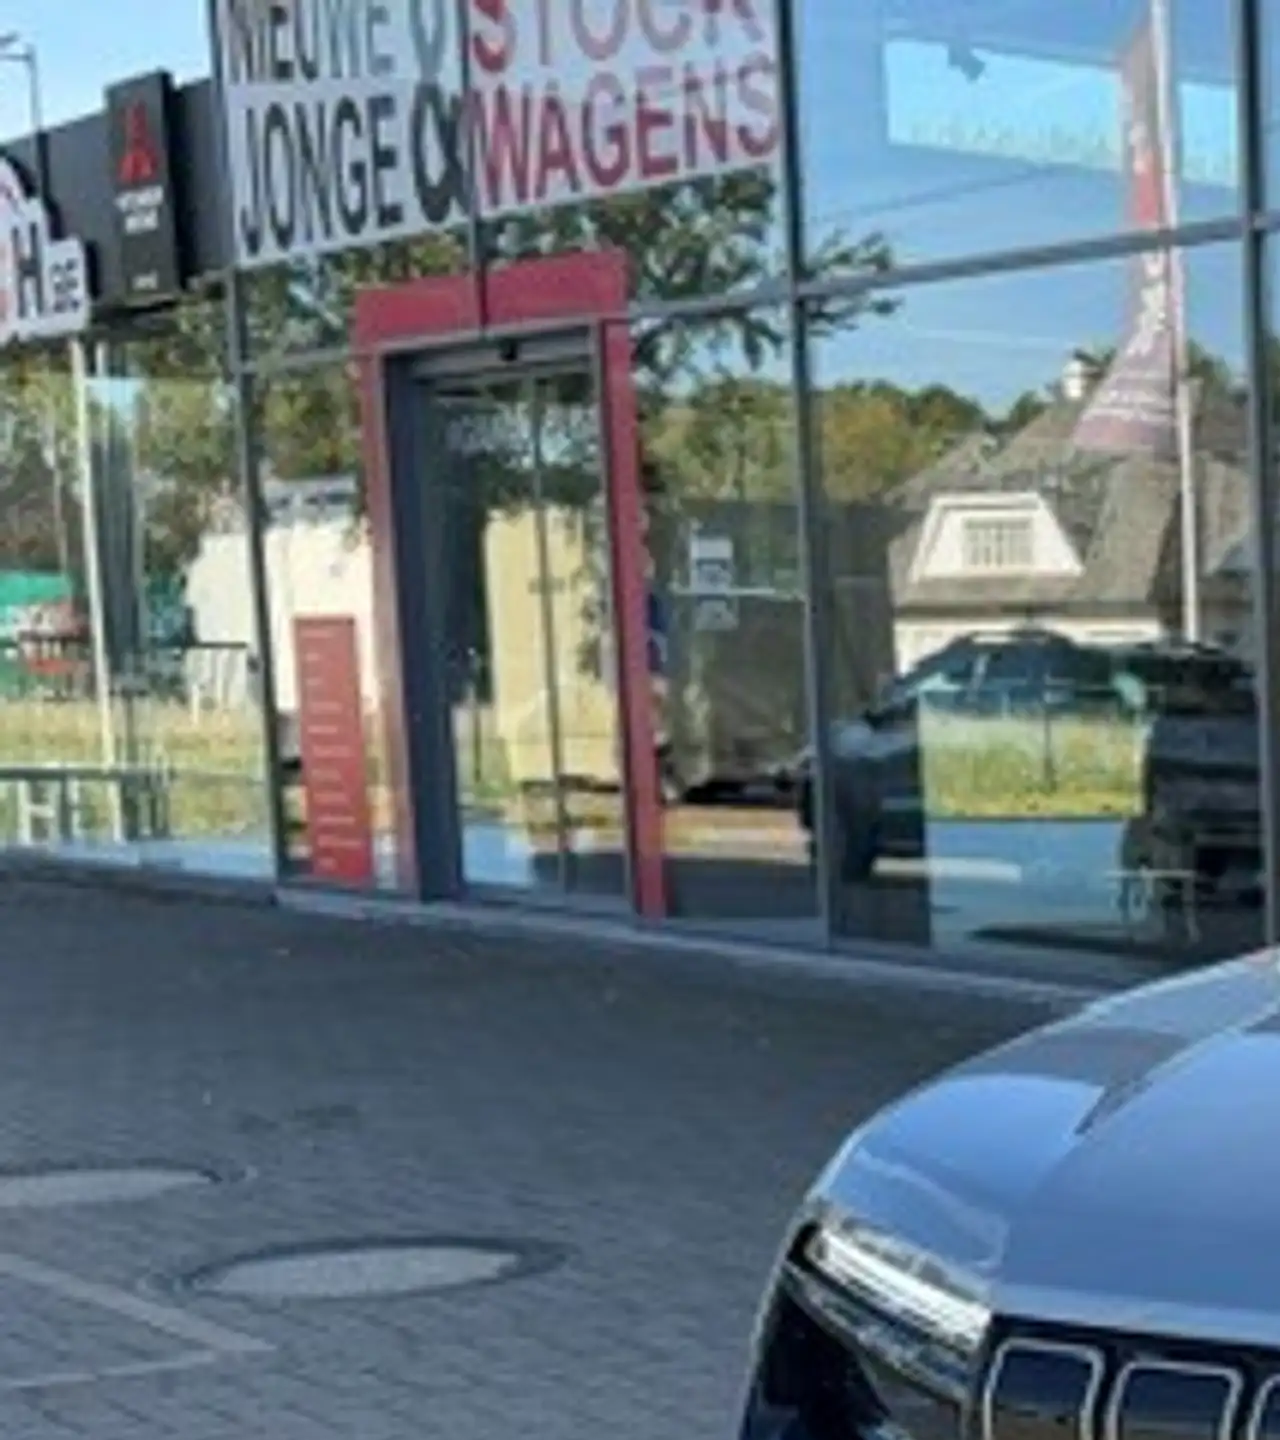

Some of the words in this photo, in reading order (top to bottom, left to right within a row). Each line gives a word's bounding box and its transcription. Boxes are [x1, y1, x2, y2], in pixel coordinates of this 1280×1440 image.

[227, 0, 395, 84] NIEUWE
[239, 95, 404, 257] JONGE
[462, 52, 778, 208] WAGENS
